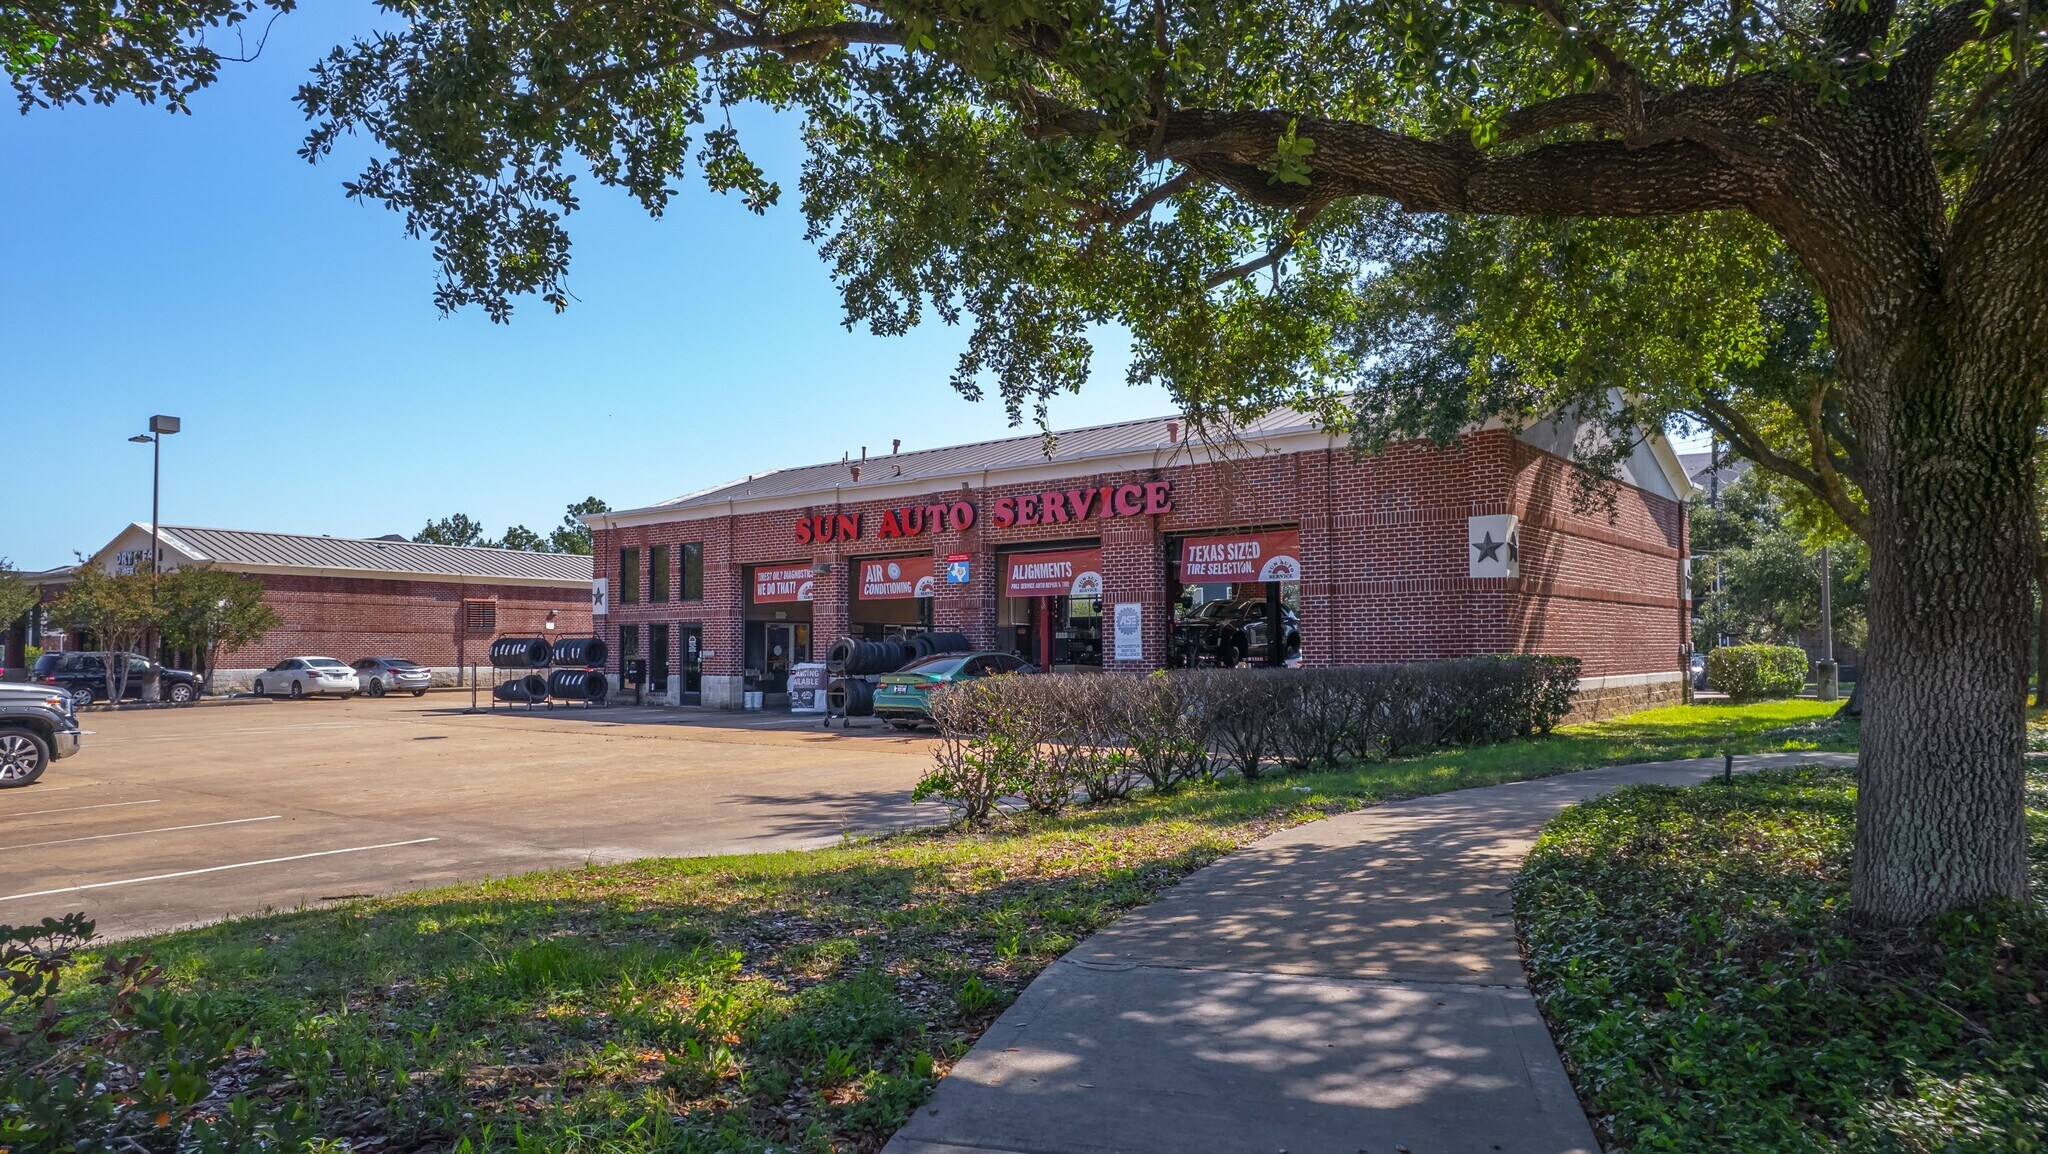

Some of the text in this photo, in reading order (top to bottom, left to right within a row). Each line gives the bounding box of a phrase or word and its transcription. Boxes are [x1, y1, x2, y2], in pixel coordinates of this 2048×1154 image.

[794, 481, 1173, 545] SUN AUTO SERVICE
[116, 551, 133, 565] DRY
[1188, 541, 1261, 562] TEXAS SIZED
[865, 564, 884, 583] AIR
[1012, 561, 1073, 580] ALIGNMENTS
[1187, 560, 1255, 575] TIRE SELECTION.
[757, 581, 797, 596] WE DO THAT!
[863, 581, 912, 595] CONDITIONING
[1120, 615, 1137, 625] ASE
